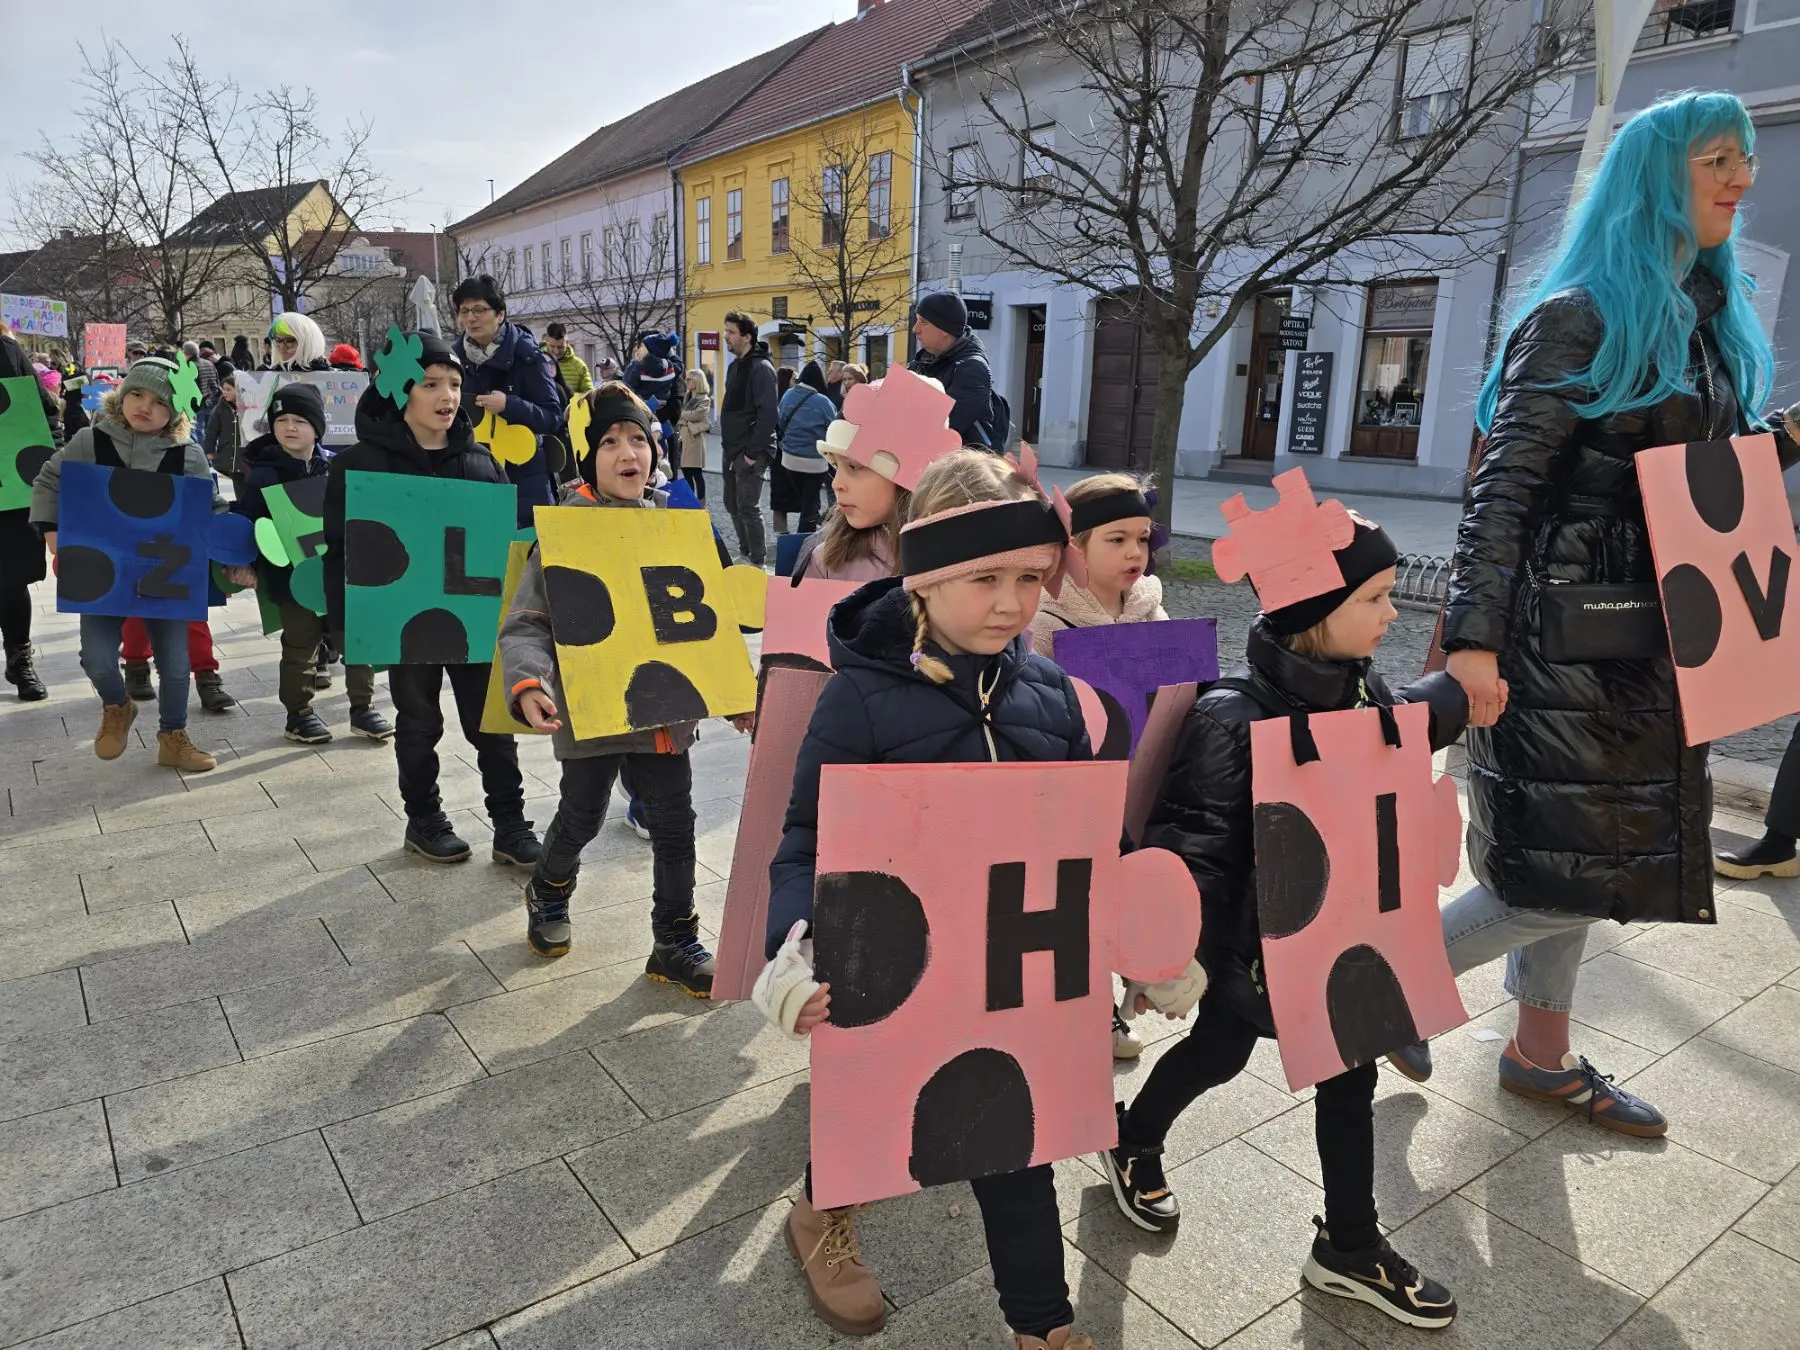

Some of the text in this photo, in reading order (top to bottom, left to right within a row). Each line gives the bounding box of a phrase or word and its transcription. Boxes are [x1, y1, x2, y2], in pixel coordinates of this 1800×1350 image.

[1281, 339, 1303, 347] SATOVI
[1283, 320, 1305, 328] OPTIKA
[1298, 391, 1322, 399] VOGUE
[137, 533, 191, 599] Ž
[443, 526, 502, 596] L
[1730, 545, 1792, 641] V
[640, 565, 718, 645] B
[1375, 792, 1402, 913] I
[986, 858, 1093, 1012] H
